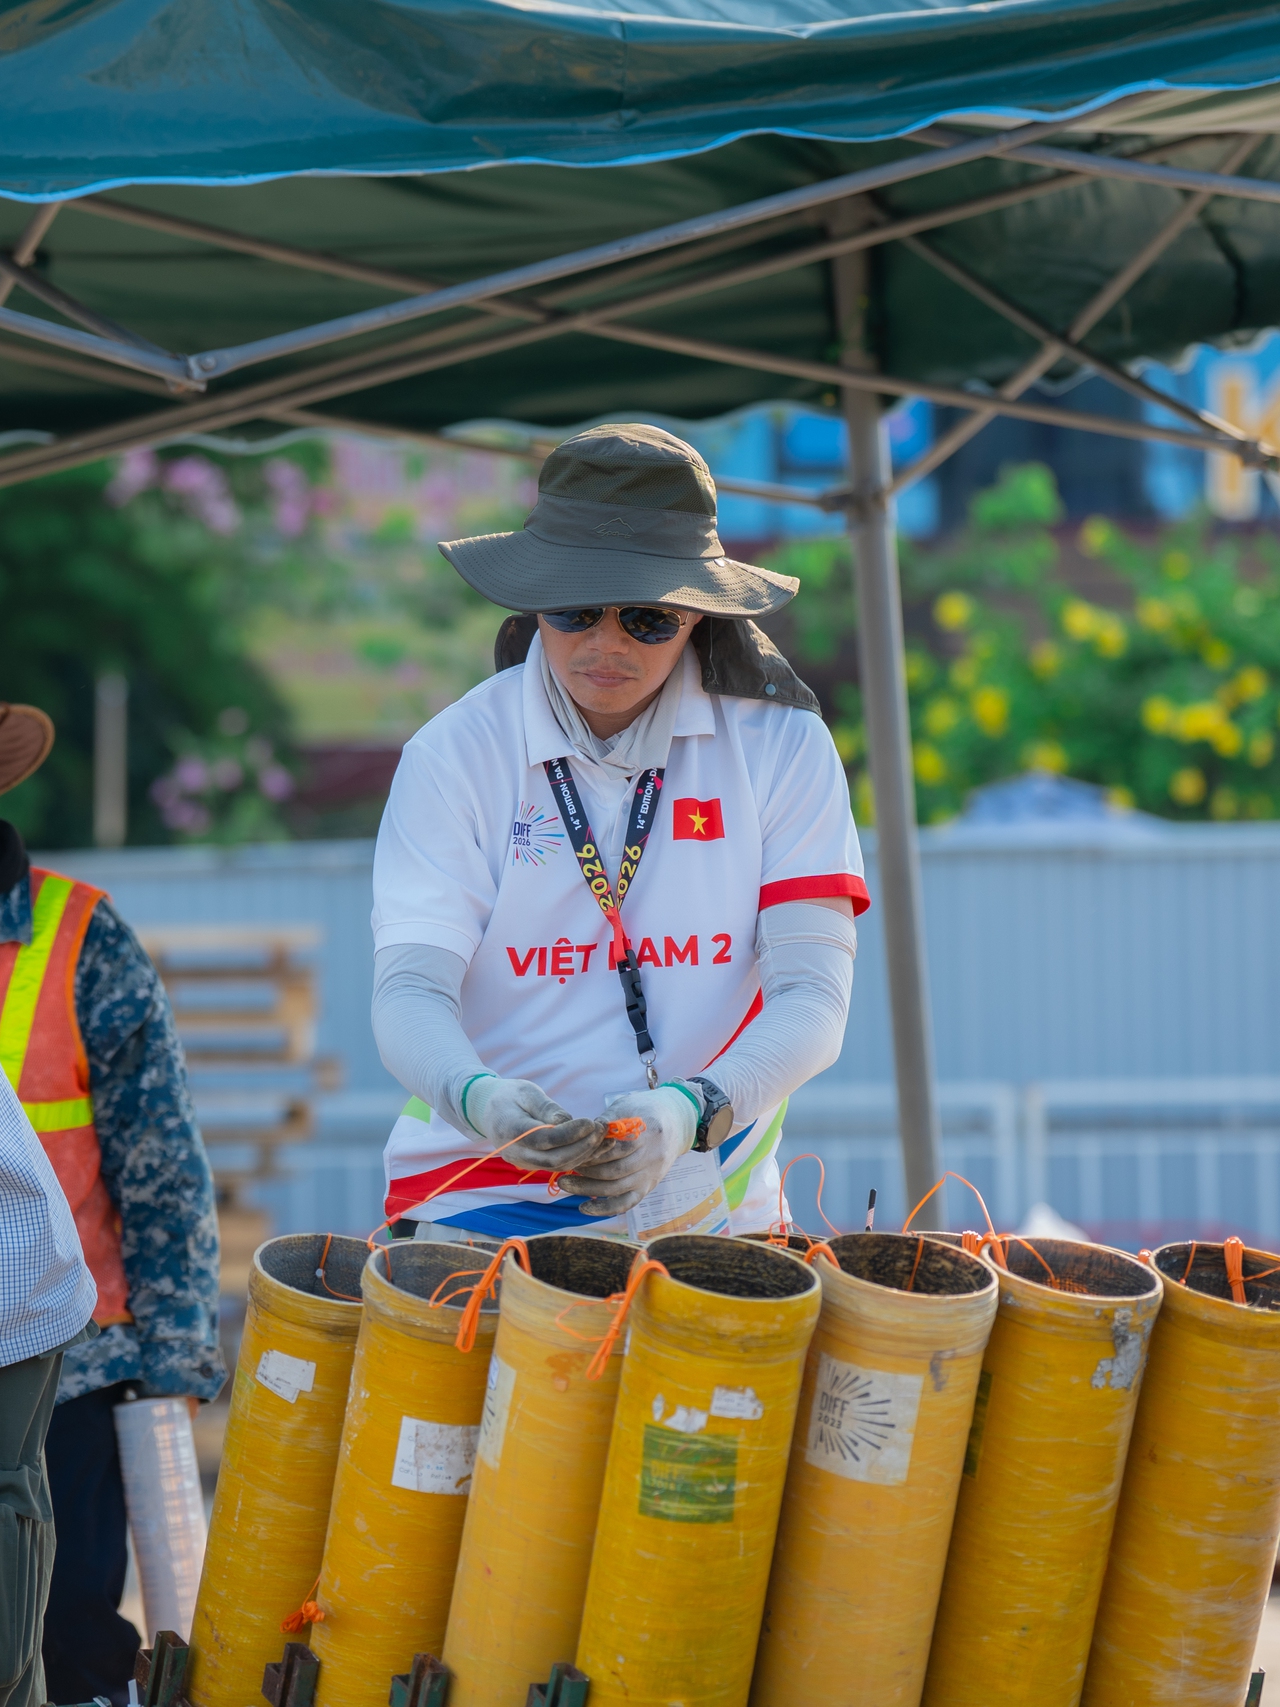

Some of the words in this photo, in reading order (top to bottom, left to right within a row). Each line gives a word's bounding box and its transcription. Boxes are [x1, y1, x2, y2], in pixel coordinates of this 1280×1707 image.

[559, 782, 577, 816] EDITION
[640, 781, 655, 814] EDITION
[512, 836, 531, 847] 2026
[513, 821, 532, 838] DIFF
[575, 843, 615, 912] 2026
[506, 937, 598, 985] VIỆT
[711, 932, 732, 965] 2
[820, 1391, 850, 1418] DIFF
[818, 1412, 843, 1430] 2023
